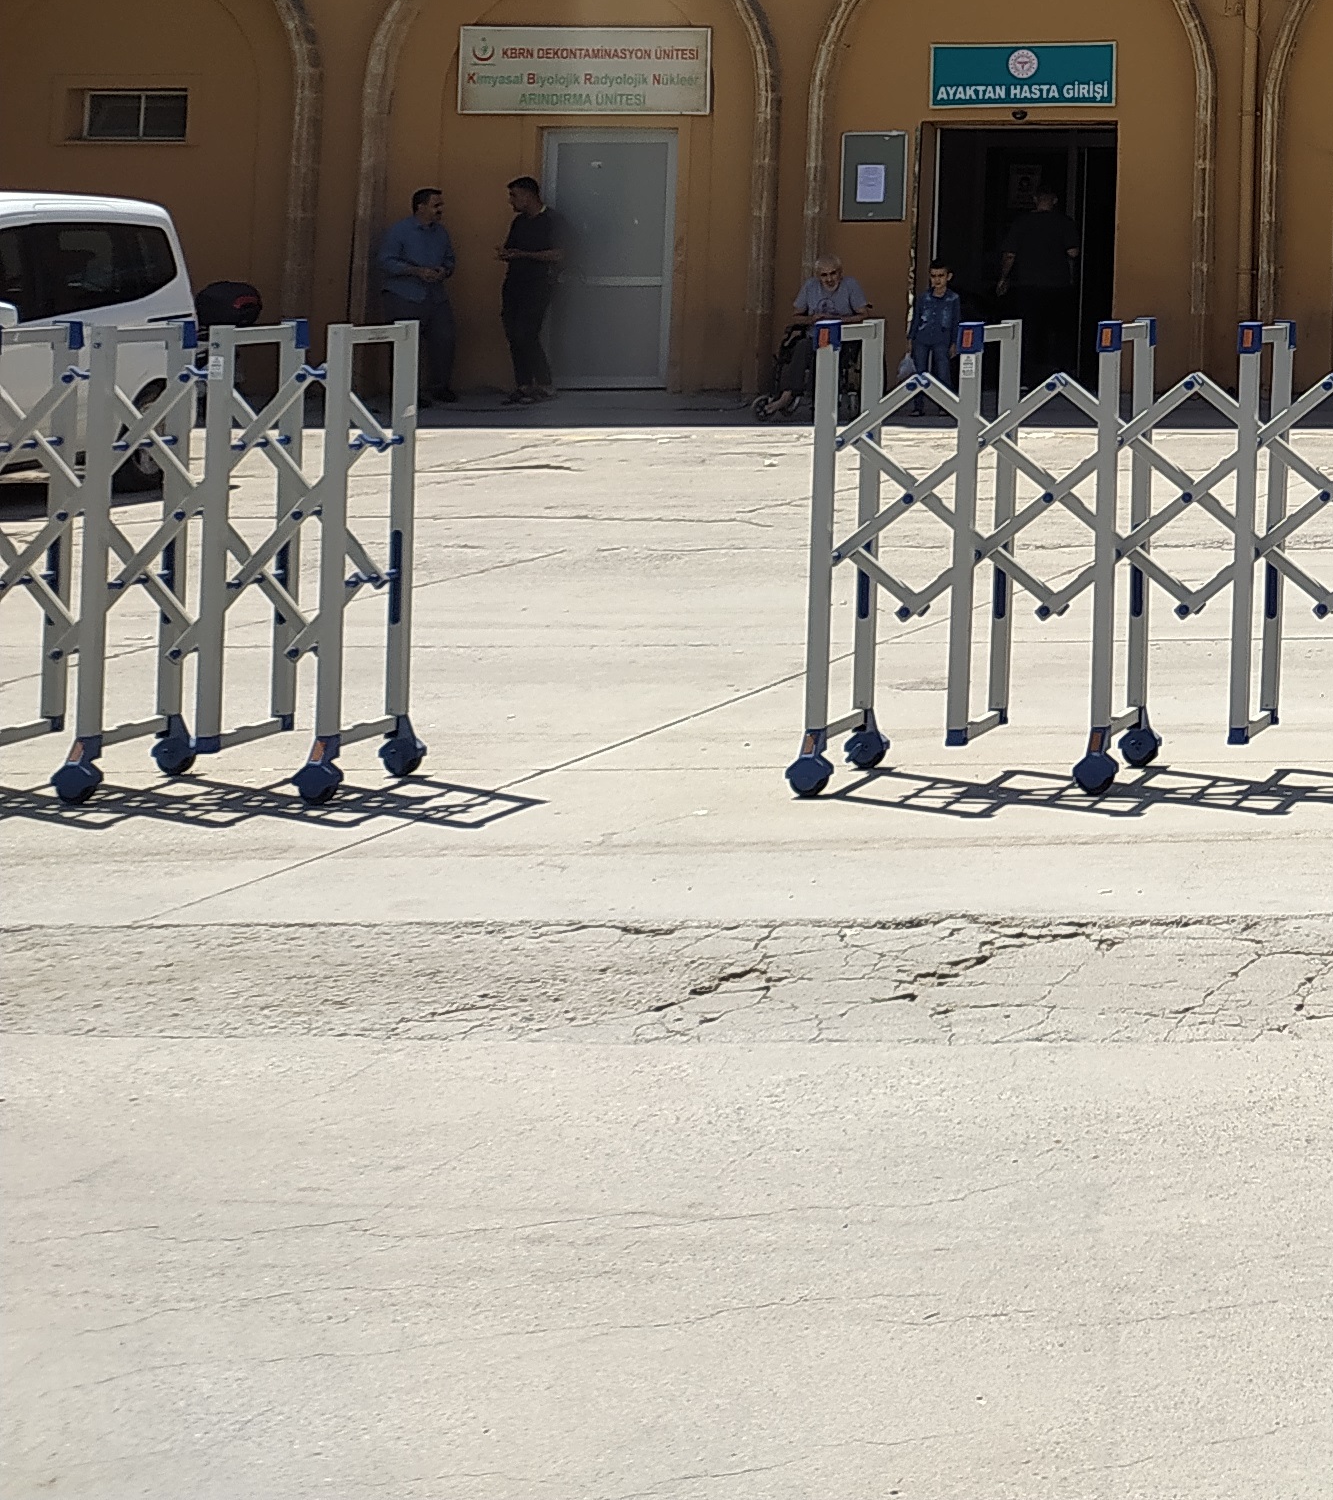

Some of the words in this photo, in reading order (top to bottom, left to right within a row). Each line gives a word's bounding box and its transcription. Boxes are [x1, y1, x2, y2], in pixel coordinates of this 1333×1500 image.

[501, 47, 534, 60] KBRN
[537, 45, 651, 60] DEKONTAMİNASYON
[654, 45, 699, 61] ÜNİTESİ
[467, 72, 523, 88] Kimyasal
[526, 72, 580, 88] Biyolojik
[583, 72, 649, 88] Radyolojik
[652, 71, 699, 86] Nükleer
[518, 94, 592, 106] ARINDIRMA
[595, 92, 647, 106] ÜNİTESİ
[936, 85, 1006, 101] AYAKTAN
[1010, 84, 1059, 99] HASTA
[1062, 81, 1108, 102] GİRİŞİ
